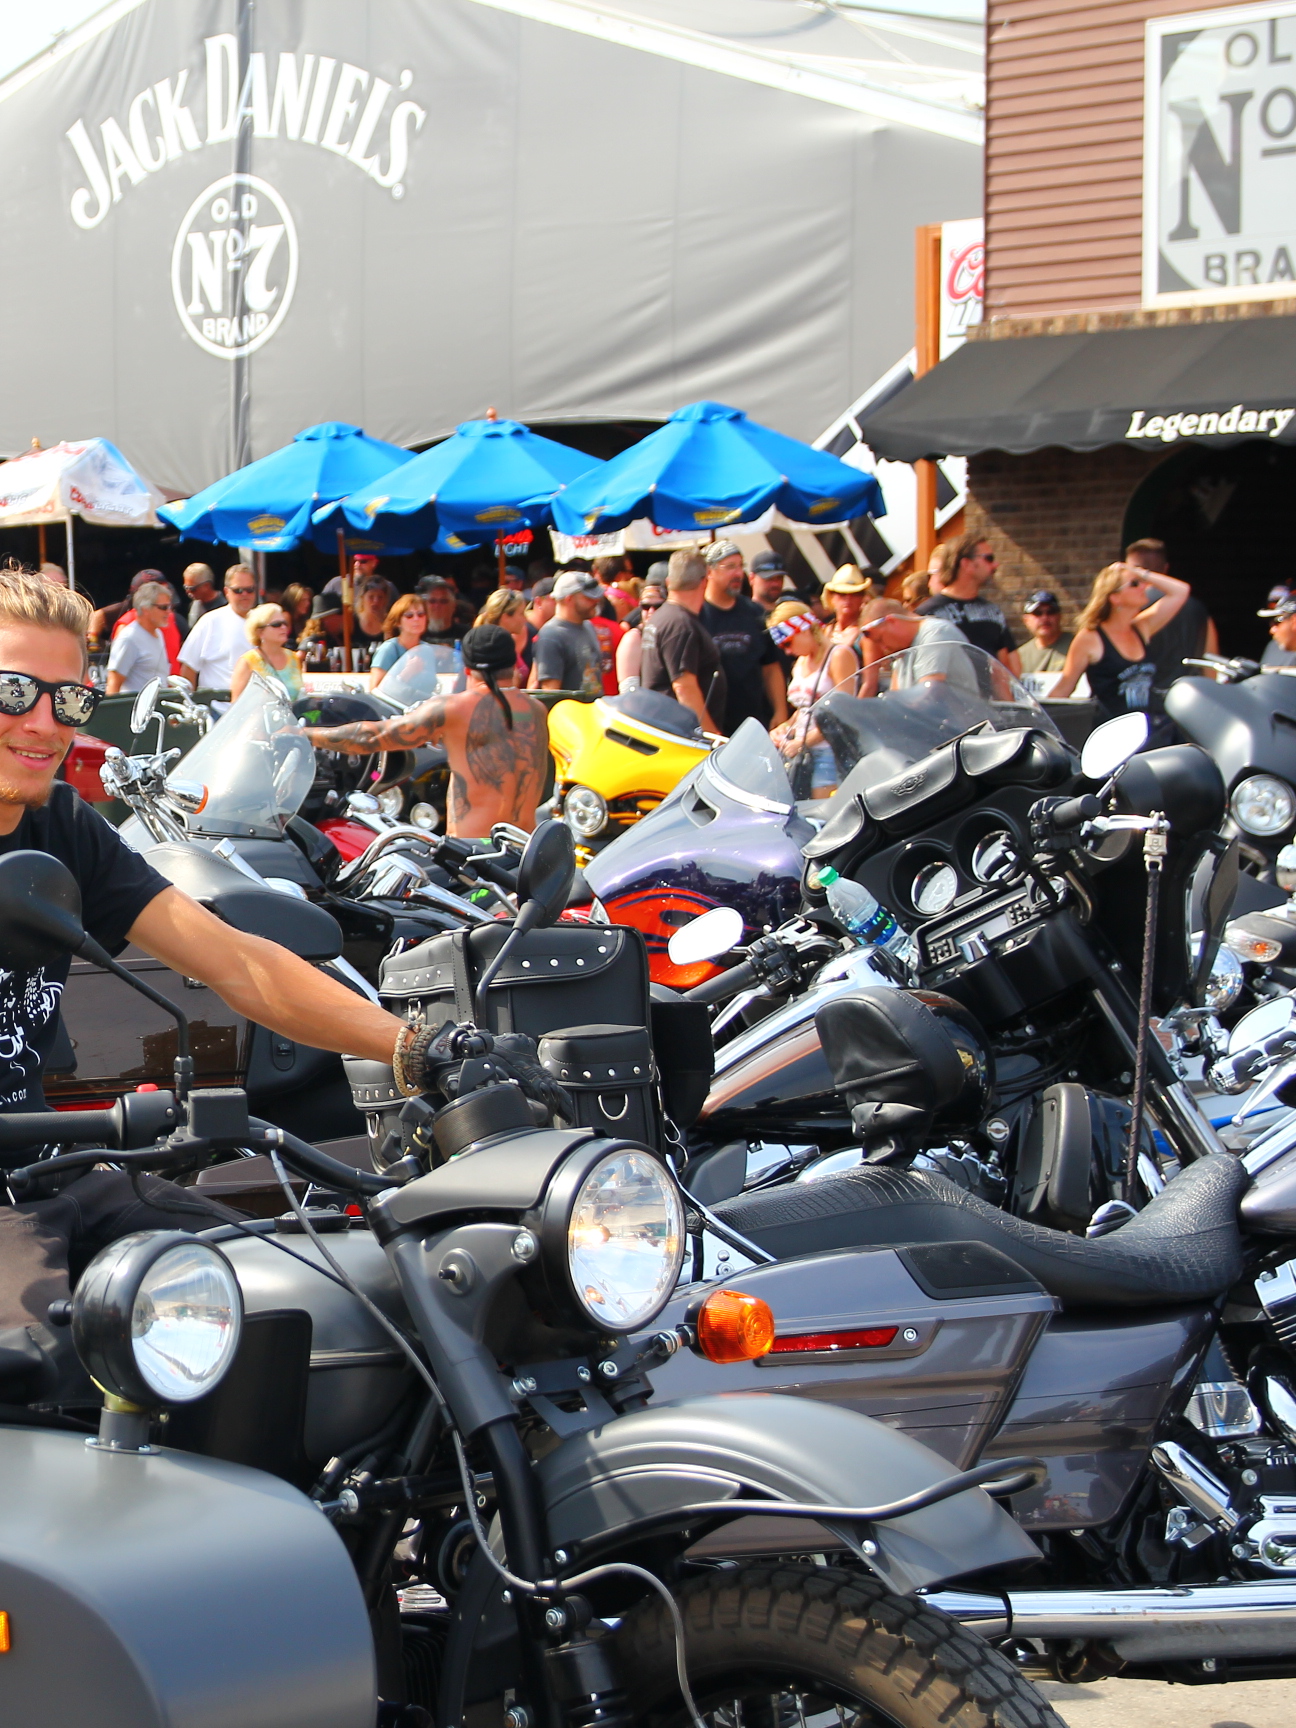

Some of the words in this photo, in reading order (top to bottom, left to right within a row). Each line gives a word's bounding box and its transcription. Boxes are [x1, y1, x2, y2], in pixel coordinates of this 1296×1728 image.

[65, 68, 202, 230] JACK
[204, 33, 427, 188] DANIEL'S
[203, 312, 269, 346] BRAND
[1125, 404, 1296, 442] Legendary
